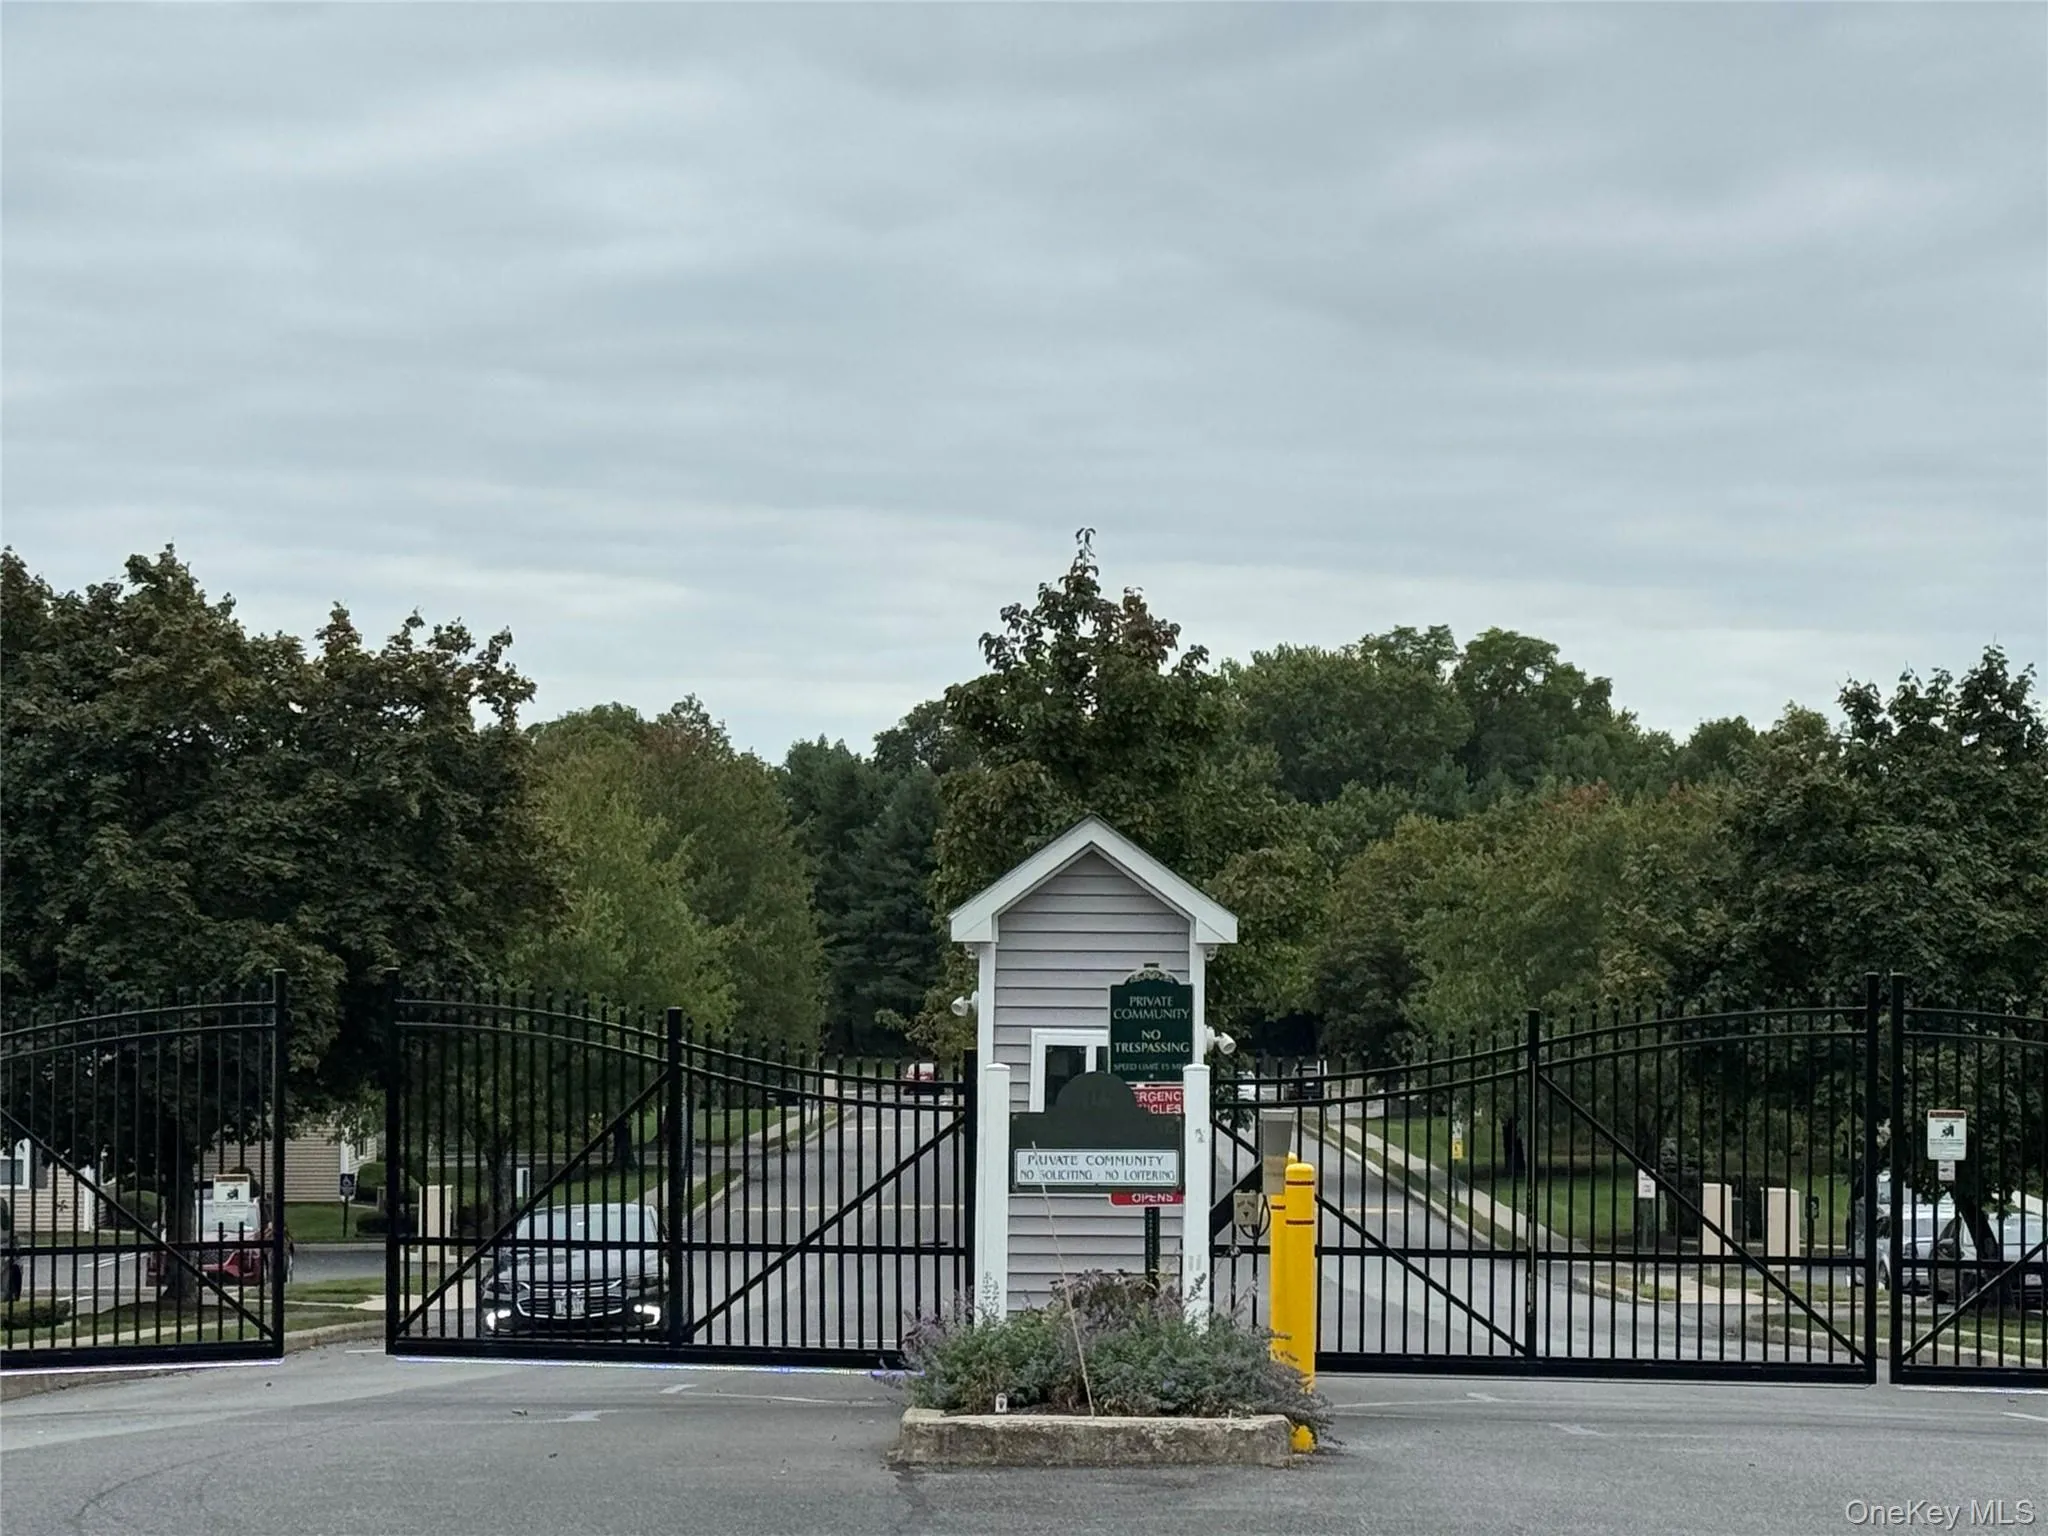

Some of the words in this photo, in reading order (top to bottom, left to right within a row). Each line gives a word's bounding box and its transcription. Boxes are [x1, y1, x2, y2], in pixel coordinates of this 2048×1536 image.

[1129, 995, 1174, 1007] PRIVATE
[1113, 1007, 1190, 1020] COMMUNITY
[1141, 1029, 1161, 1040] NO
[1114, 1041, 1190, 1053] TRESPASSING
[1027, 1155, 1078, 1166] PRIVATE
[1085, 1155, 1164, 1166] COMMUNITY
[1020, 1169, 1034, 1181] NO
[1040, 1169, 1093, 1181] SOLICITING
[1105, 1169, 1119, 1181] NO
[1124, 1169, 1175, 1181] LOITERING
